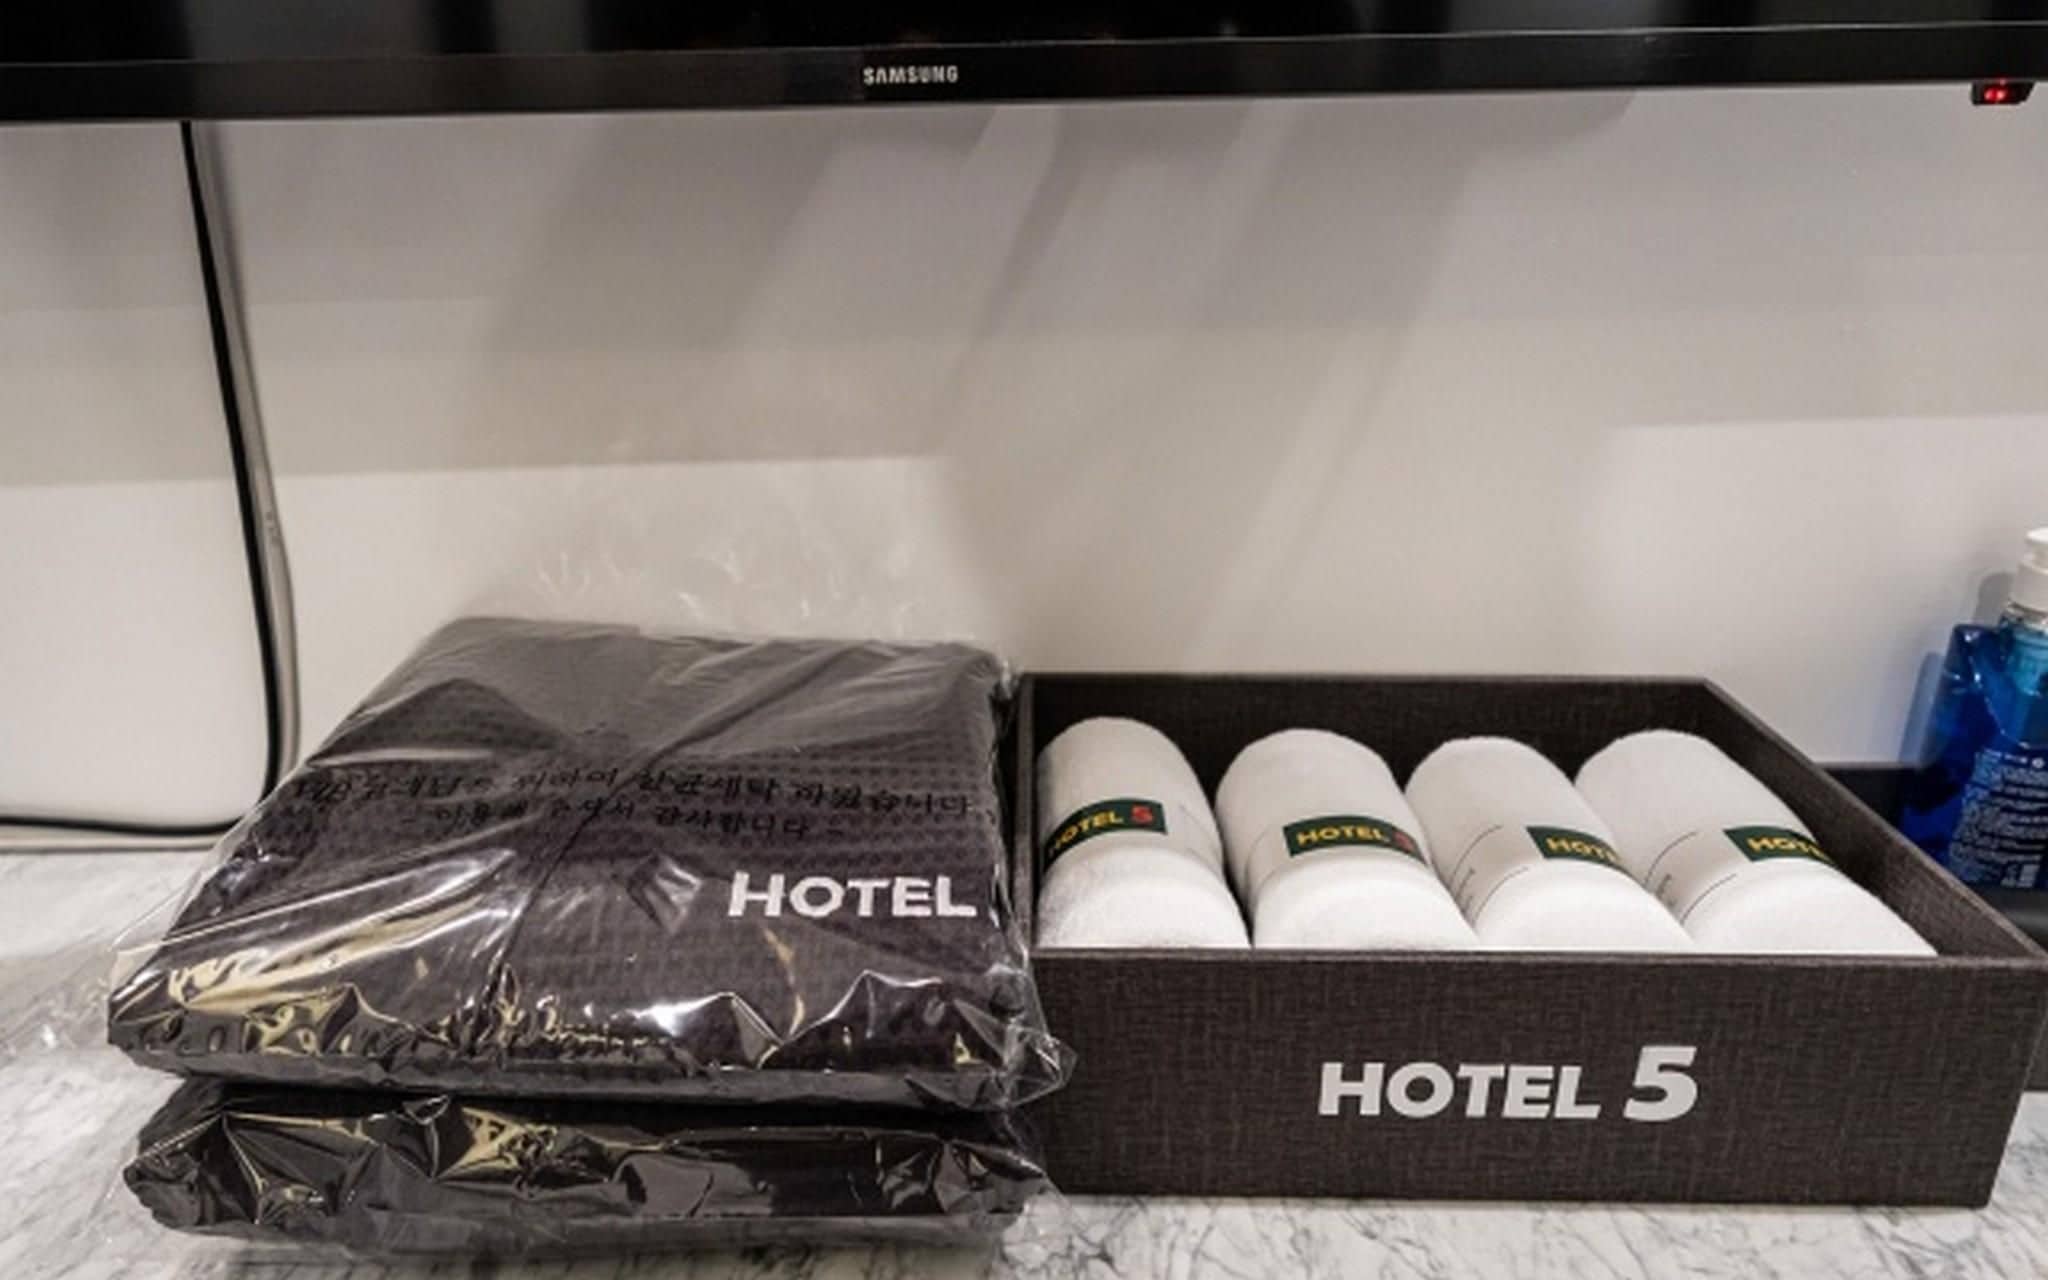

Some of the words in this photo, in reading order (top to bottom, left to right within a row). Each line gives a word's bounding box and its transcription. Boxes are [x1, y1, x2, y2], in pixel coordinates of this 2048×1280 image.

[863, 65, 959, 86] SAMSUNG
[654, 804, 811, 839] 감사합니다
[1295, 824, 1390, 846] HOTEL
[727, 870, 978, 918] HOTEL
[1317, 1061, 1602, 1119] HOTEL
[1622, 1044, 1699, 1122] 5
